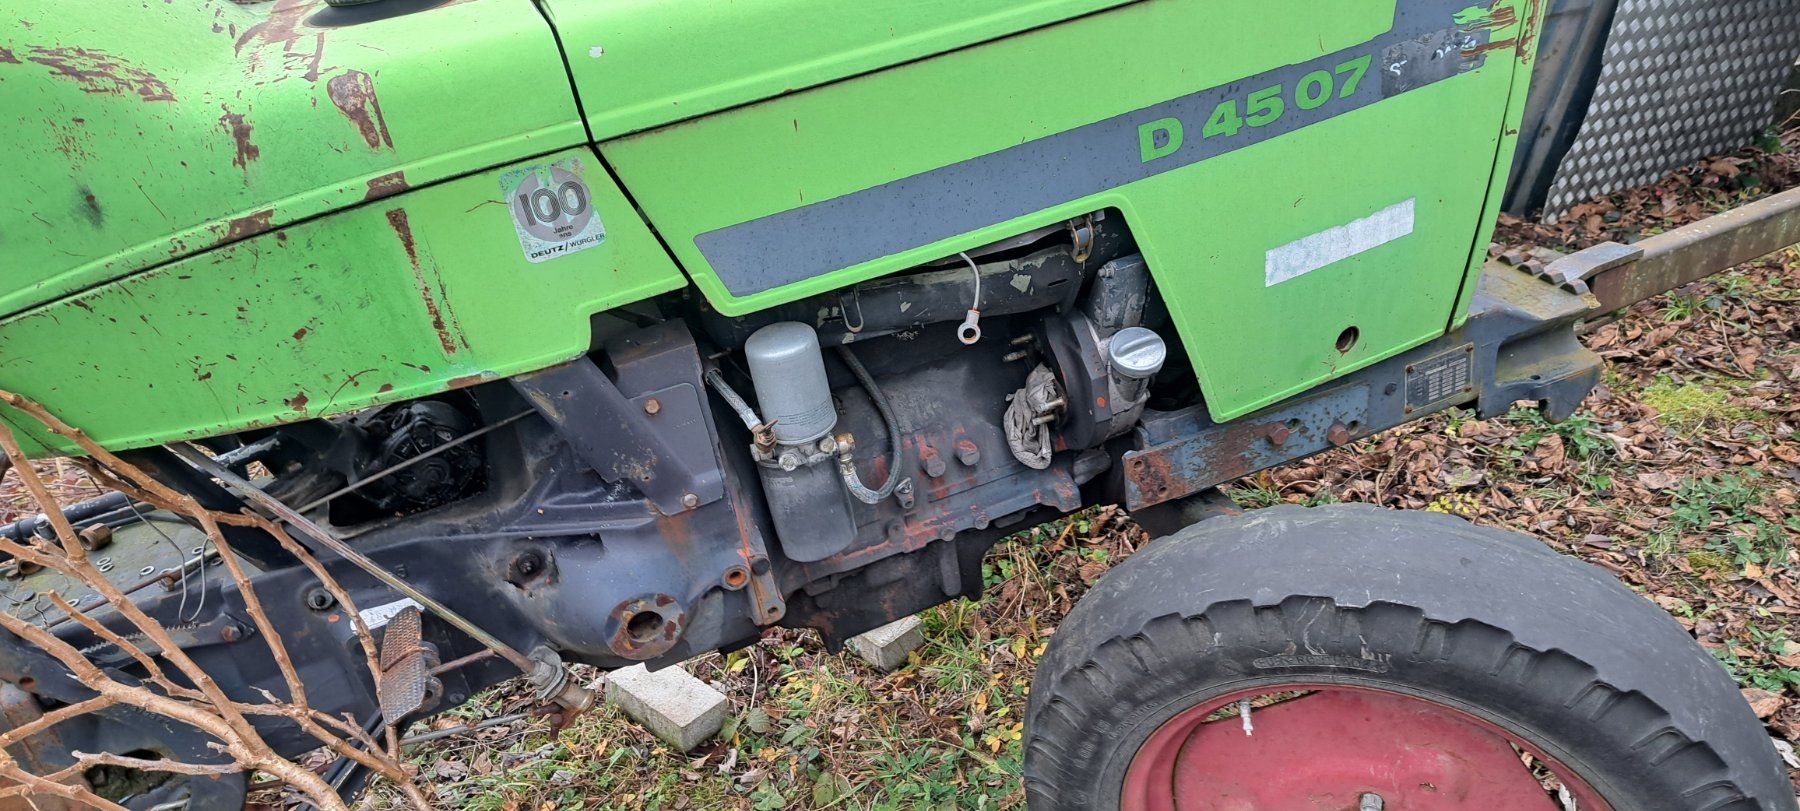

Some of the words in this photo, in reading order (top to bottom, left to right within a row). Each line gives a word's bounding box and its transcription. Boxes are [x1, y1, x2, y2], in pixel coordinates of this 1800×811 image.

[1137, 117, 1184, 163] D
[519, 180, 587, 227] 100
[553, 224, 574, 234] Jahre
